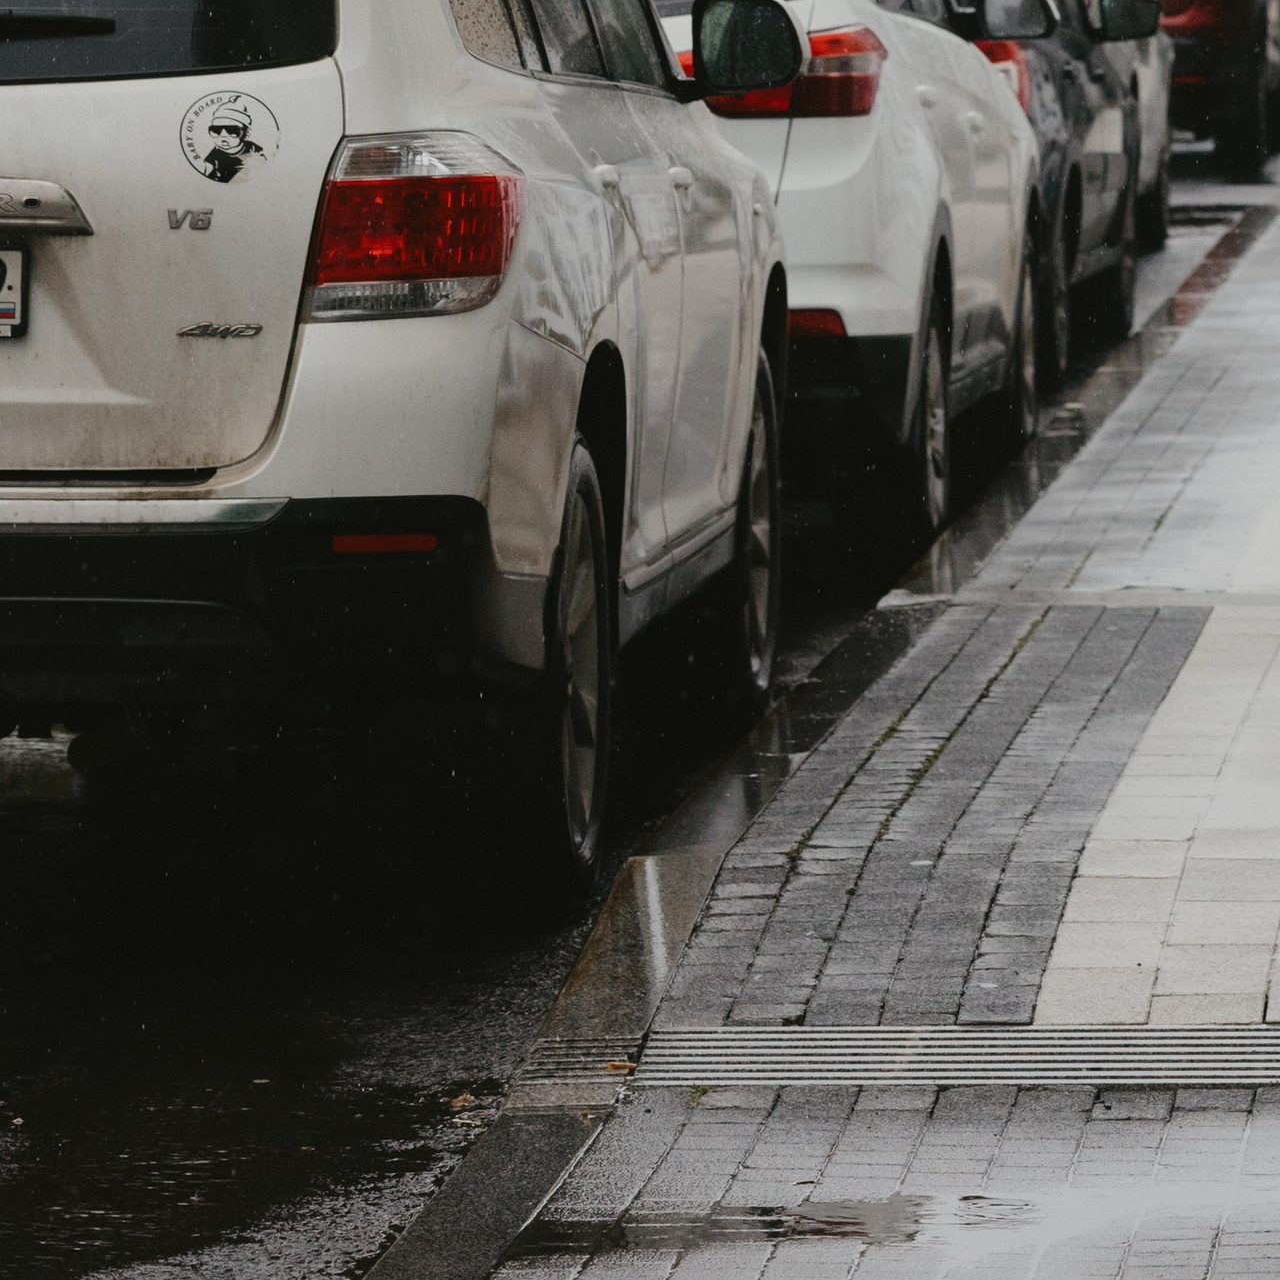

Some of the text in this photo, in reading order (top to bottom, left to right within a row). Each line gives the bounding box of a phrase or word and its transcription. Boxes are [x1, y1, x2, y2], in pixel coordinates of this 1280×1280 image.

[185, 96, 223, 161] BABY ON BOARD
[167, 208, 214, 230] V6
[176, 320, 264, 338] 4WD
